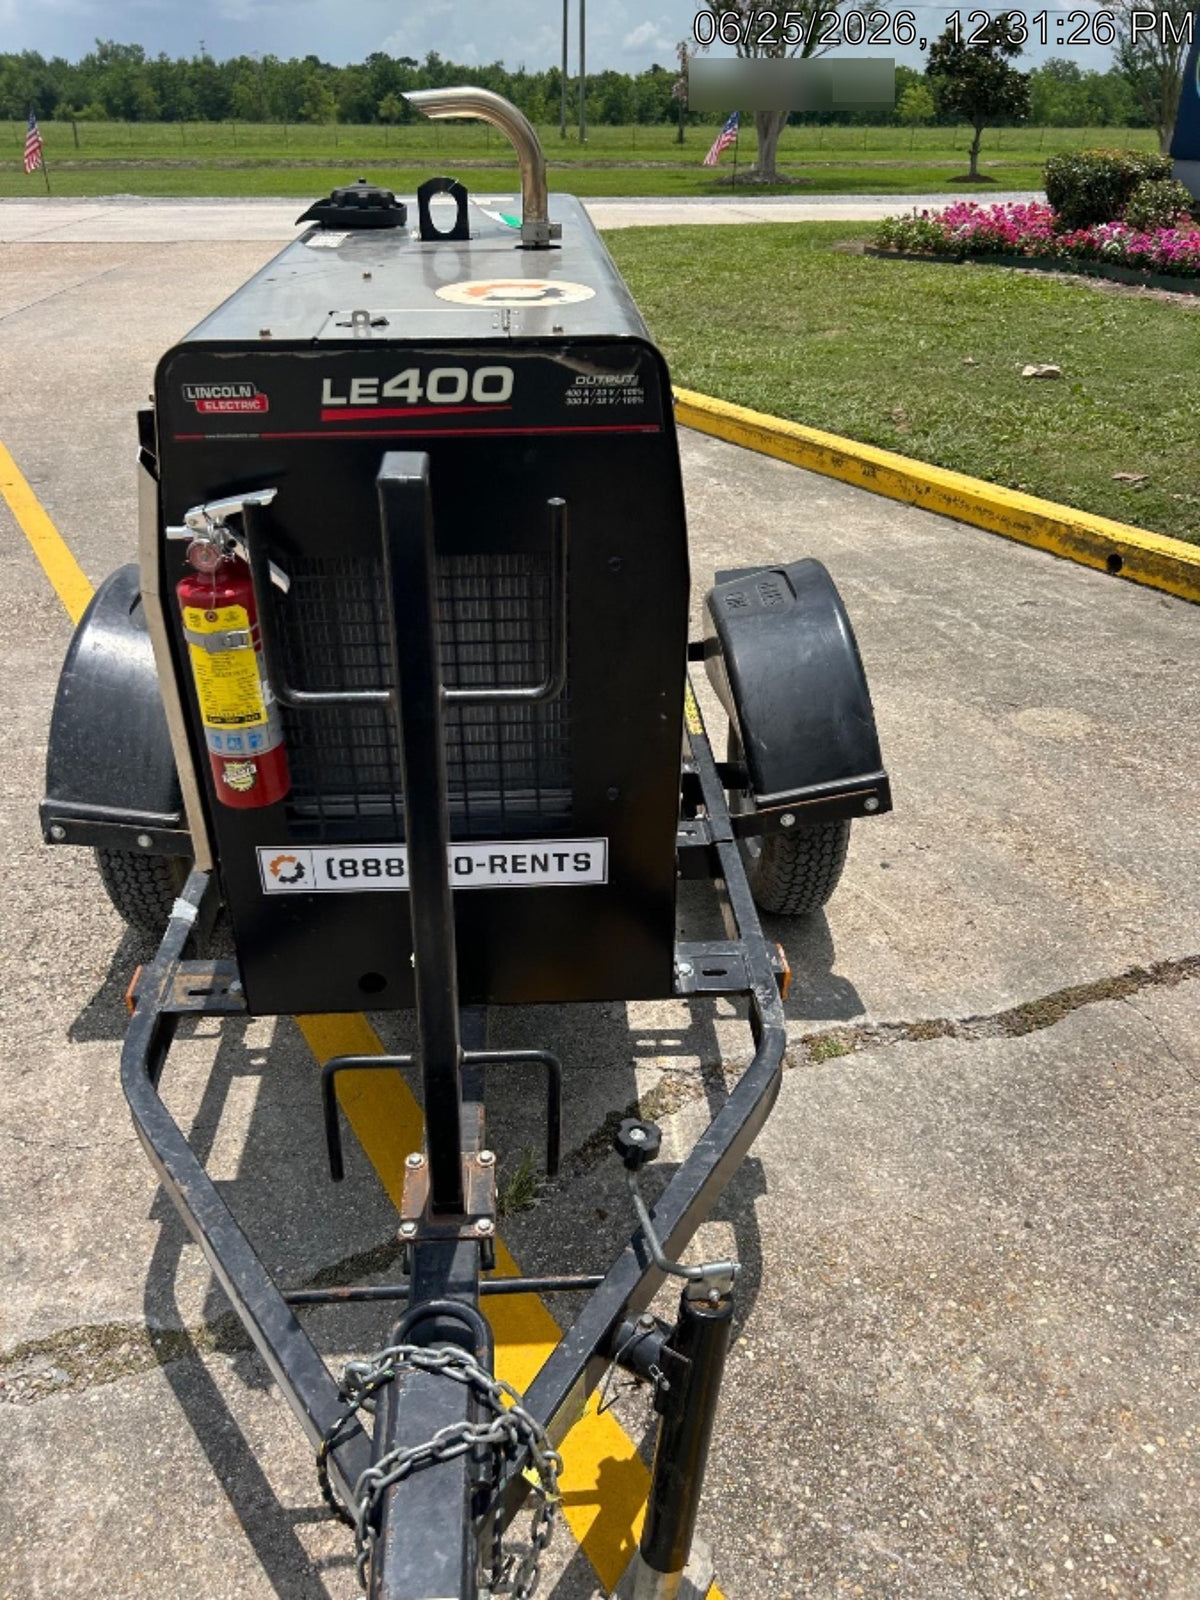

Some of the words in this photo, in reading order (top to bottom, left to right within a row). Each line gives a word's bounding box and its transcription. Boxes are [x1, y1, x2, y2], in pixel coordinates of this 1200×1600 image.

[321, 365, 515, 405] LE400
[575, 374, 638, 386] OUTPUT
[186, 385, 252, 399] LINCOLN
[204, 400, 261, 410] ELECTRIC
